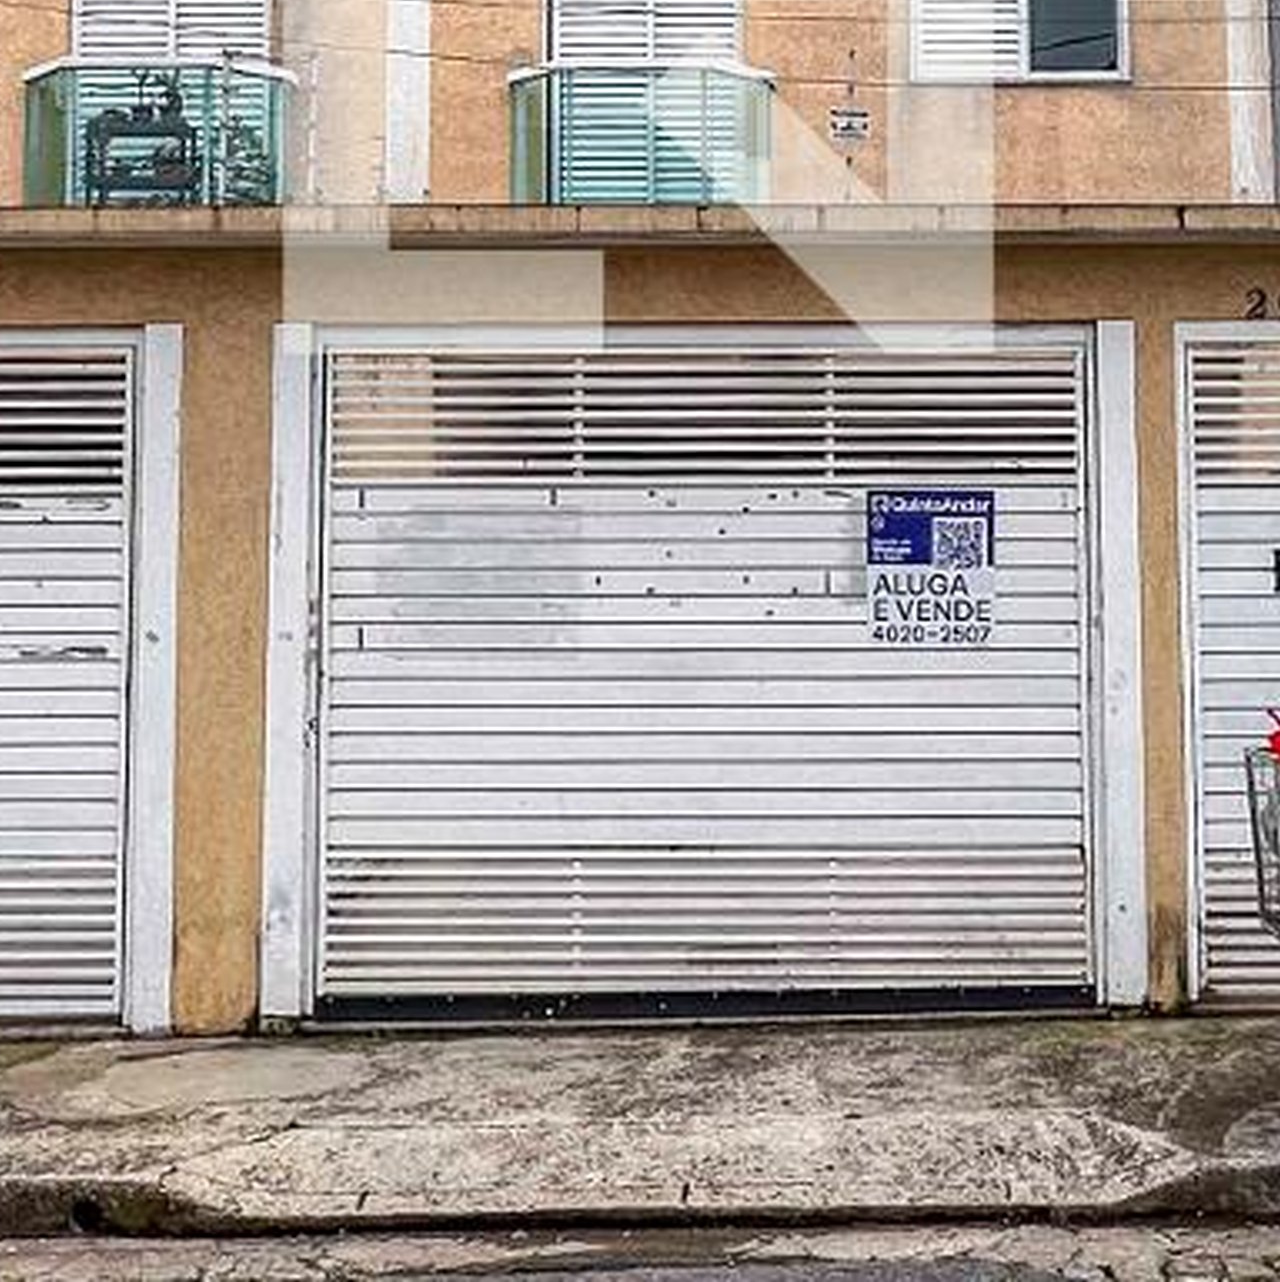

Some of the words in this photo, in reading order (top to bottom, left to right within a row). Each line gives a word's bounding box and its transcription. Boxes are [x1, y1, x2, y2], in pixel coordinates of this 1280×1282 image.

[873, 573, 969, 596] ALUGA
[873, 600, 888, 622] E
[895, 600, 992, 622] VENDE
[872, 624, 992, 643] 4020-2507
